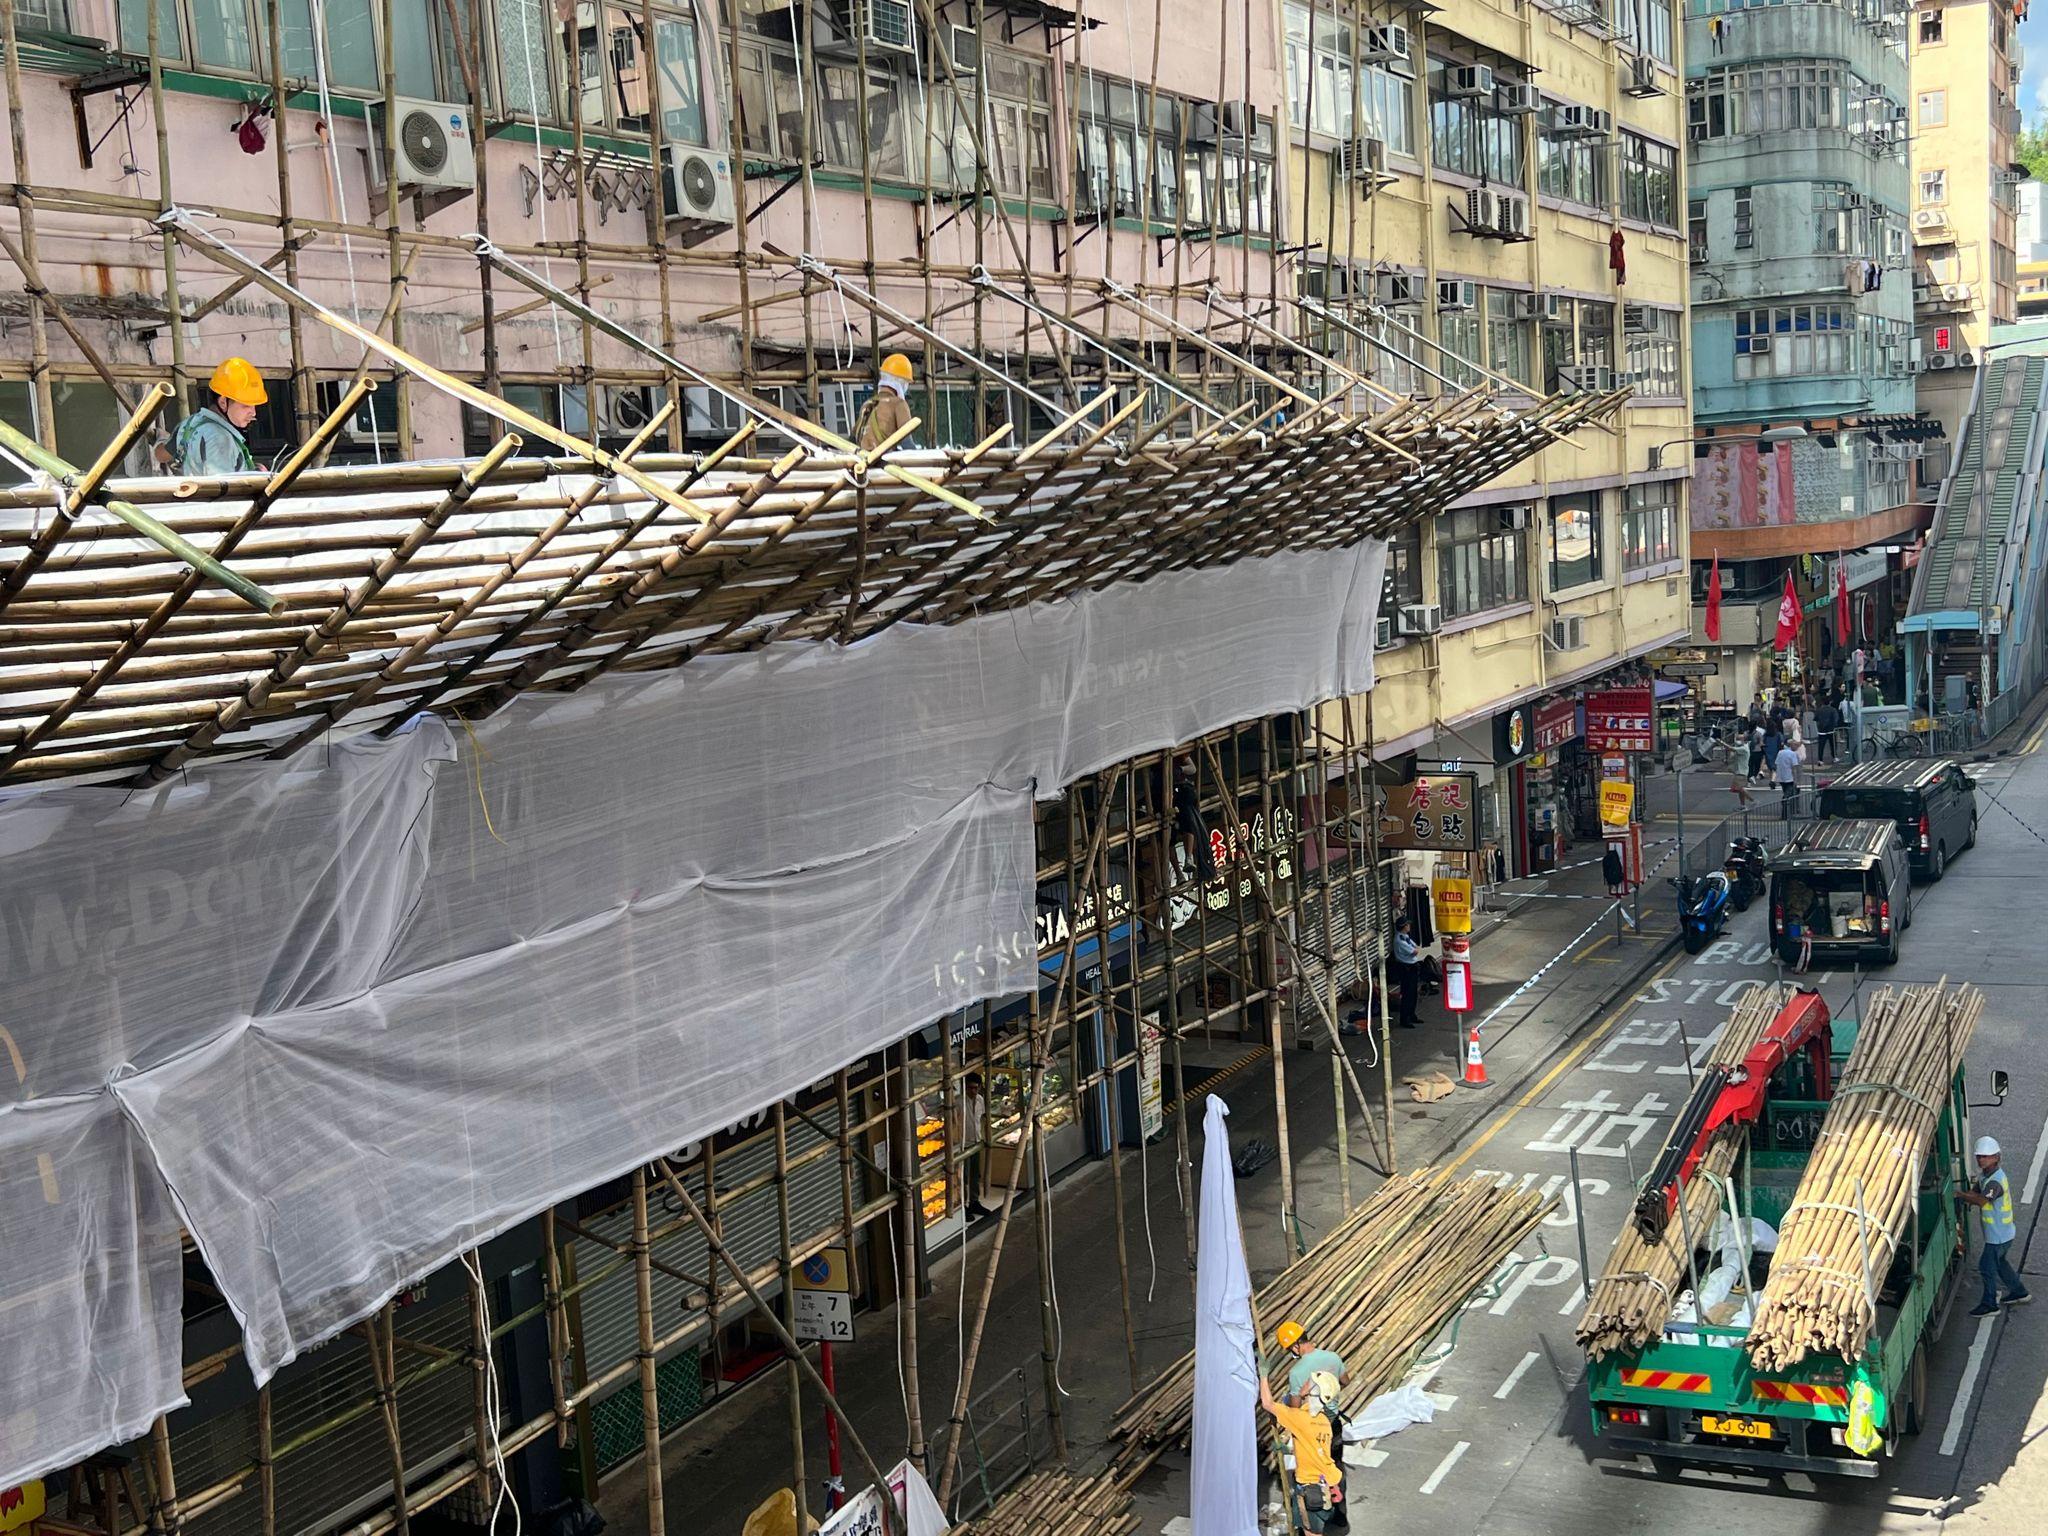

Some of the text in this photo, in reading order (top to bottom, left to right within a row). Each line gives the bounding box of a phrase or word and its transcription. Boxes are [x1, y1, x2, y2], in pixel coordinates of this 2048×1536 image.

[1604, 791, 1627, 803] KMB
[1410, 811, 1466, 841] 包點
[1438, 891, 1463, 903] KMB
[1693, 940, 1775, 966] BU
[1085, 960, 1112, 981] HEALY
[827, 1296, 838, 1312] 7
[830, 1320, 849, 1336] 12
[1713, 1419, 1760, 1436] XJ 901
